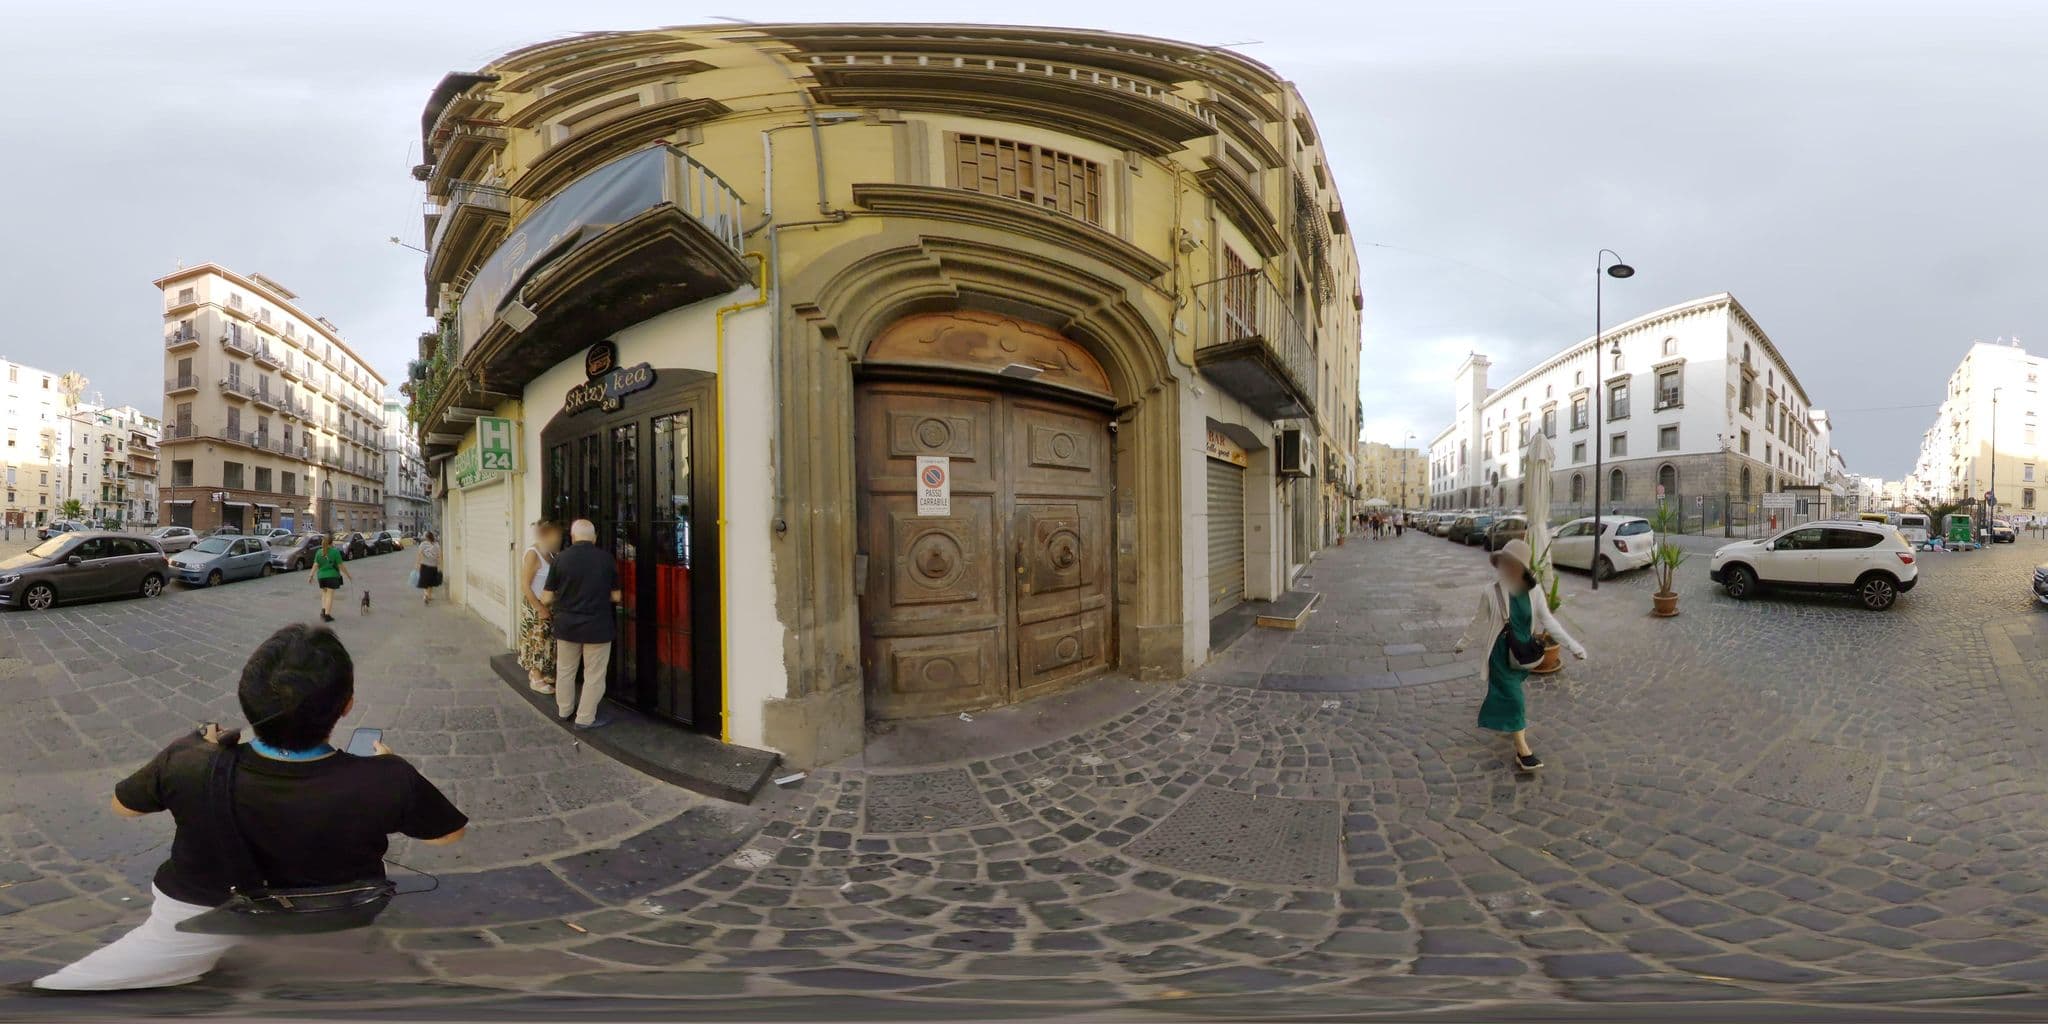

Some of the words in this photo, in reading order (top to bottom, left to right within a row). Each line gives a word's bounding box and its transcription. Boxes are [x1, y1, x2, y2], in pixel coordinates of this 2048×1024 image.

[613, 368, 647, 391] kea
[602, 398, 616, 410] 2.0
[482, 420, 510, 450] H
[1208, 431, 1224, 446] BAR
[484, 452, 511, 469] 24
[925, 488, 942, 497] PASSO
[920, 497, 948, 506] CARRABILE
